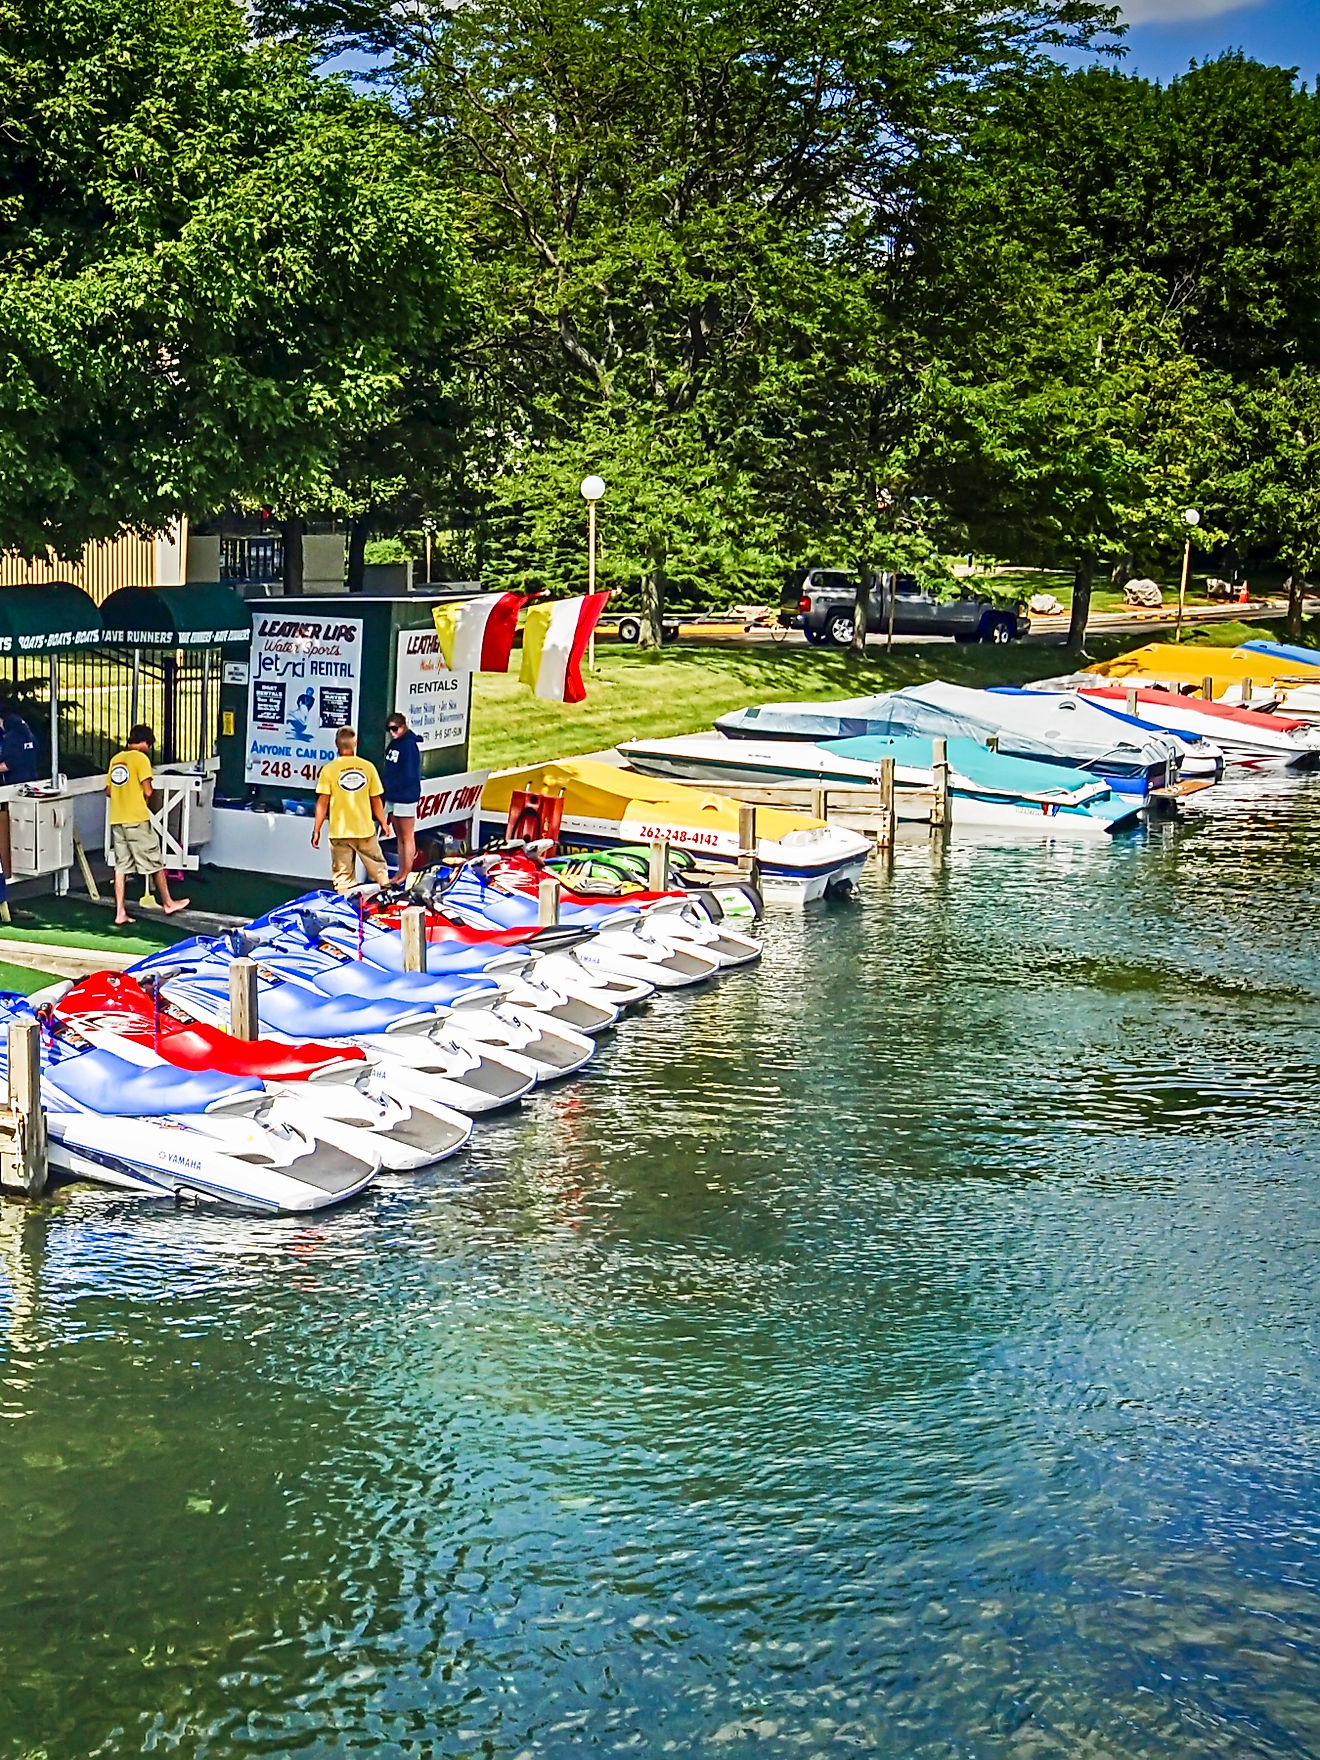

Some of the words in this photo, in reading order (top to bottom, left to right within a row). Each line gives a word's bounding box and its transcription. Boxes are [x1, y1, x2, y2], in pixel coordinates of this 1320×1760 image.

[101, 629, 124, 642] AVE
[127, 629, 174, 644] RUNNERS
[258, 619, 322, 639] LEATHER
[323, 624, 357, 643] LIPS
[264, 638, 300, 654] Water
[303, 640, 342, 659] Sports
[310, 660, 355, 678] RENTAL
[409, 679, 459, 695] RENTALS
[250, 739, 292, 757] ANYONE
[295, 747, 317, 759] CAN
[319, 749, 335, 760] DO
[167, 1152, 202, 1170] YAMAHA
